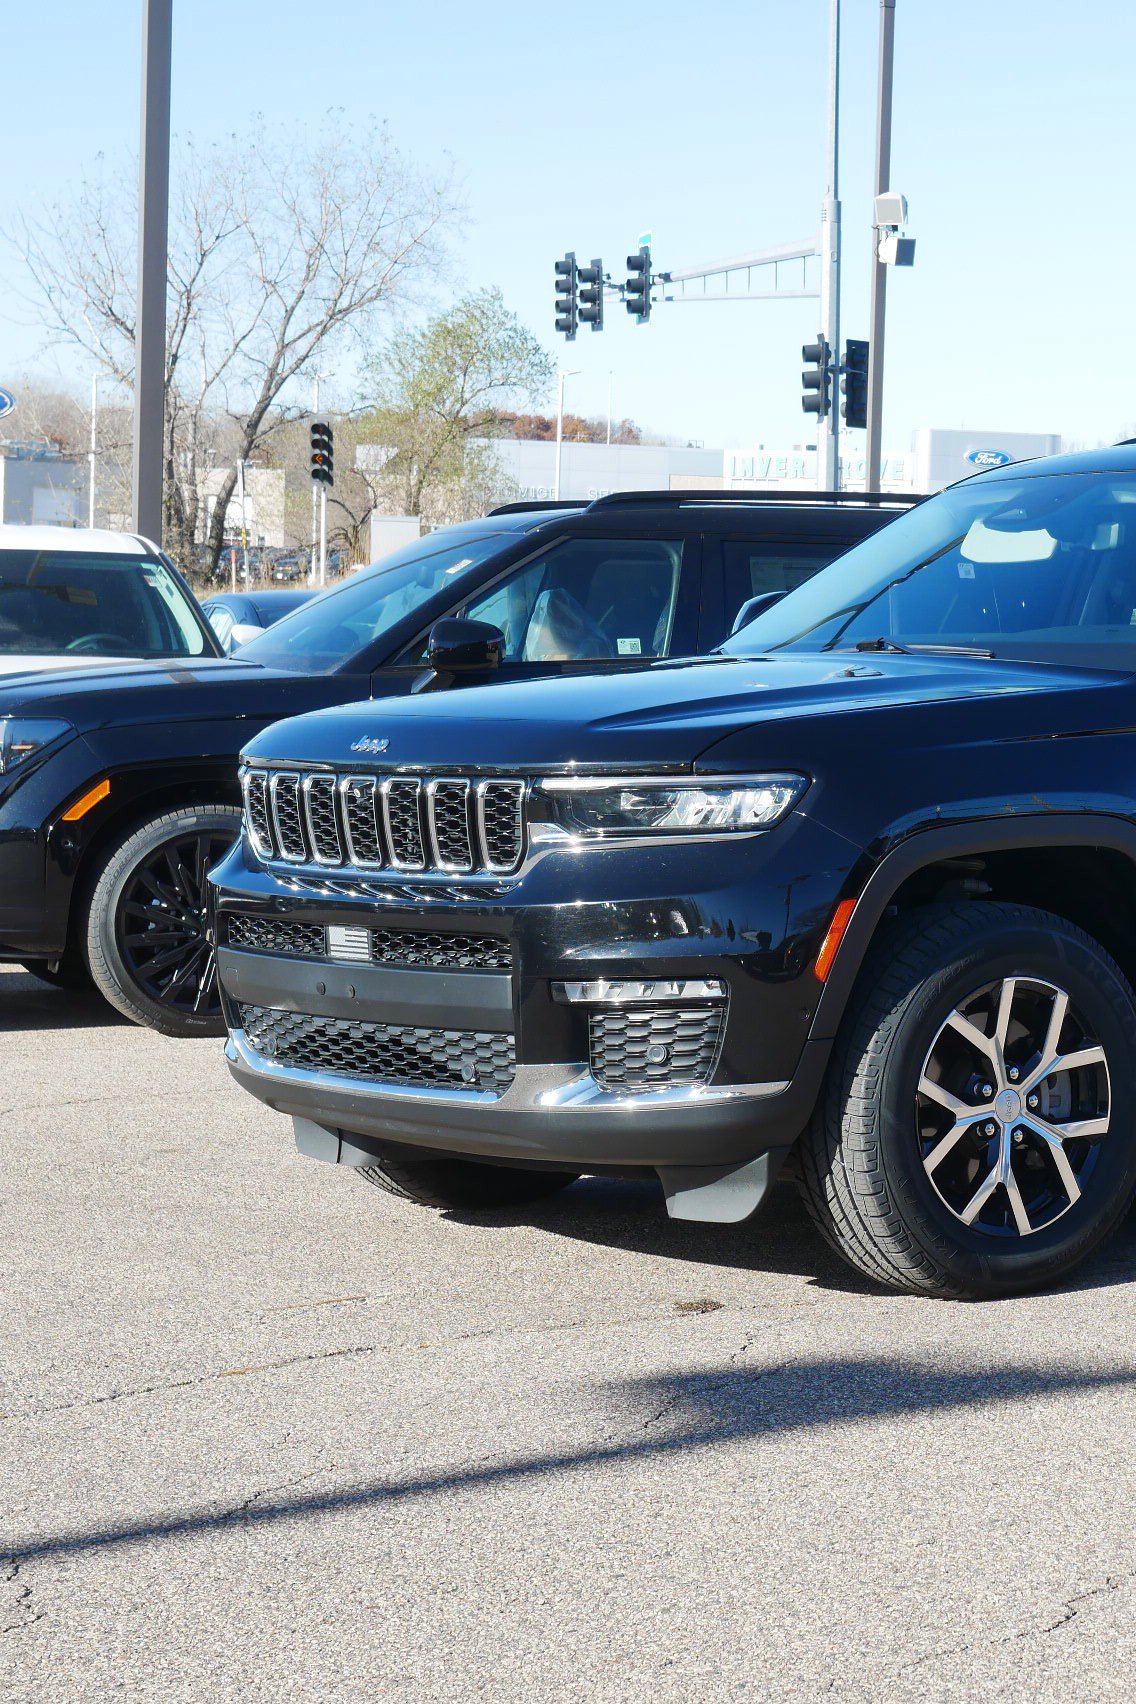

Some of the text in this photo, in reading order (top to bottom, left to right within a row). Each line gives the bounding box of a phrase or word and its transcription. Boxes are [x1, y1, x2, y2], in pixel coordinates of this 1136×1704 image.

[730, 455, 906, 481] INVER ROVE
[350, 735, 391, 755] Jeep
